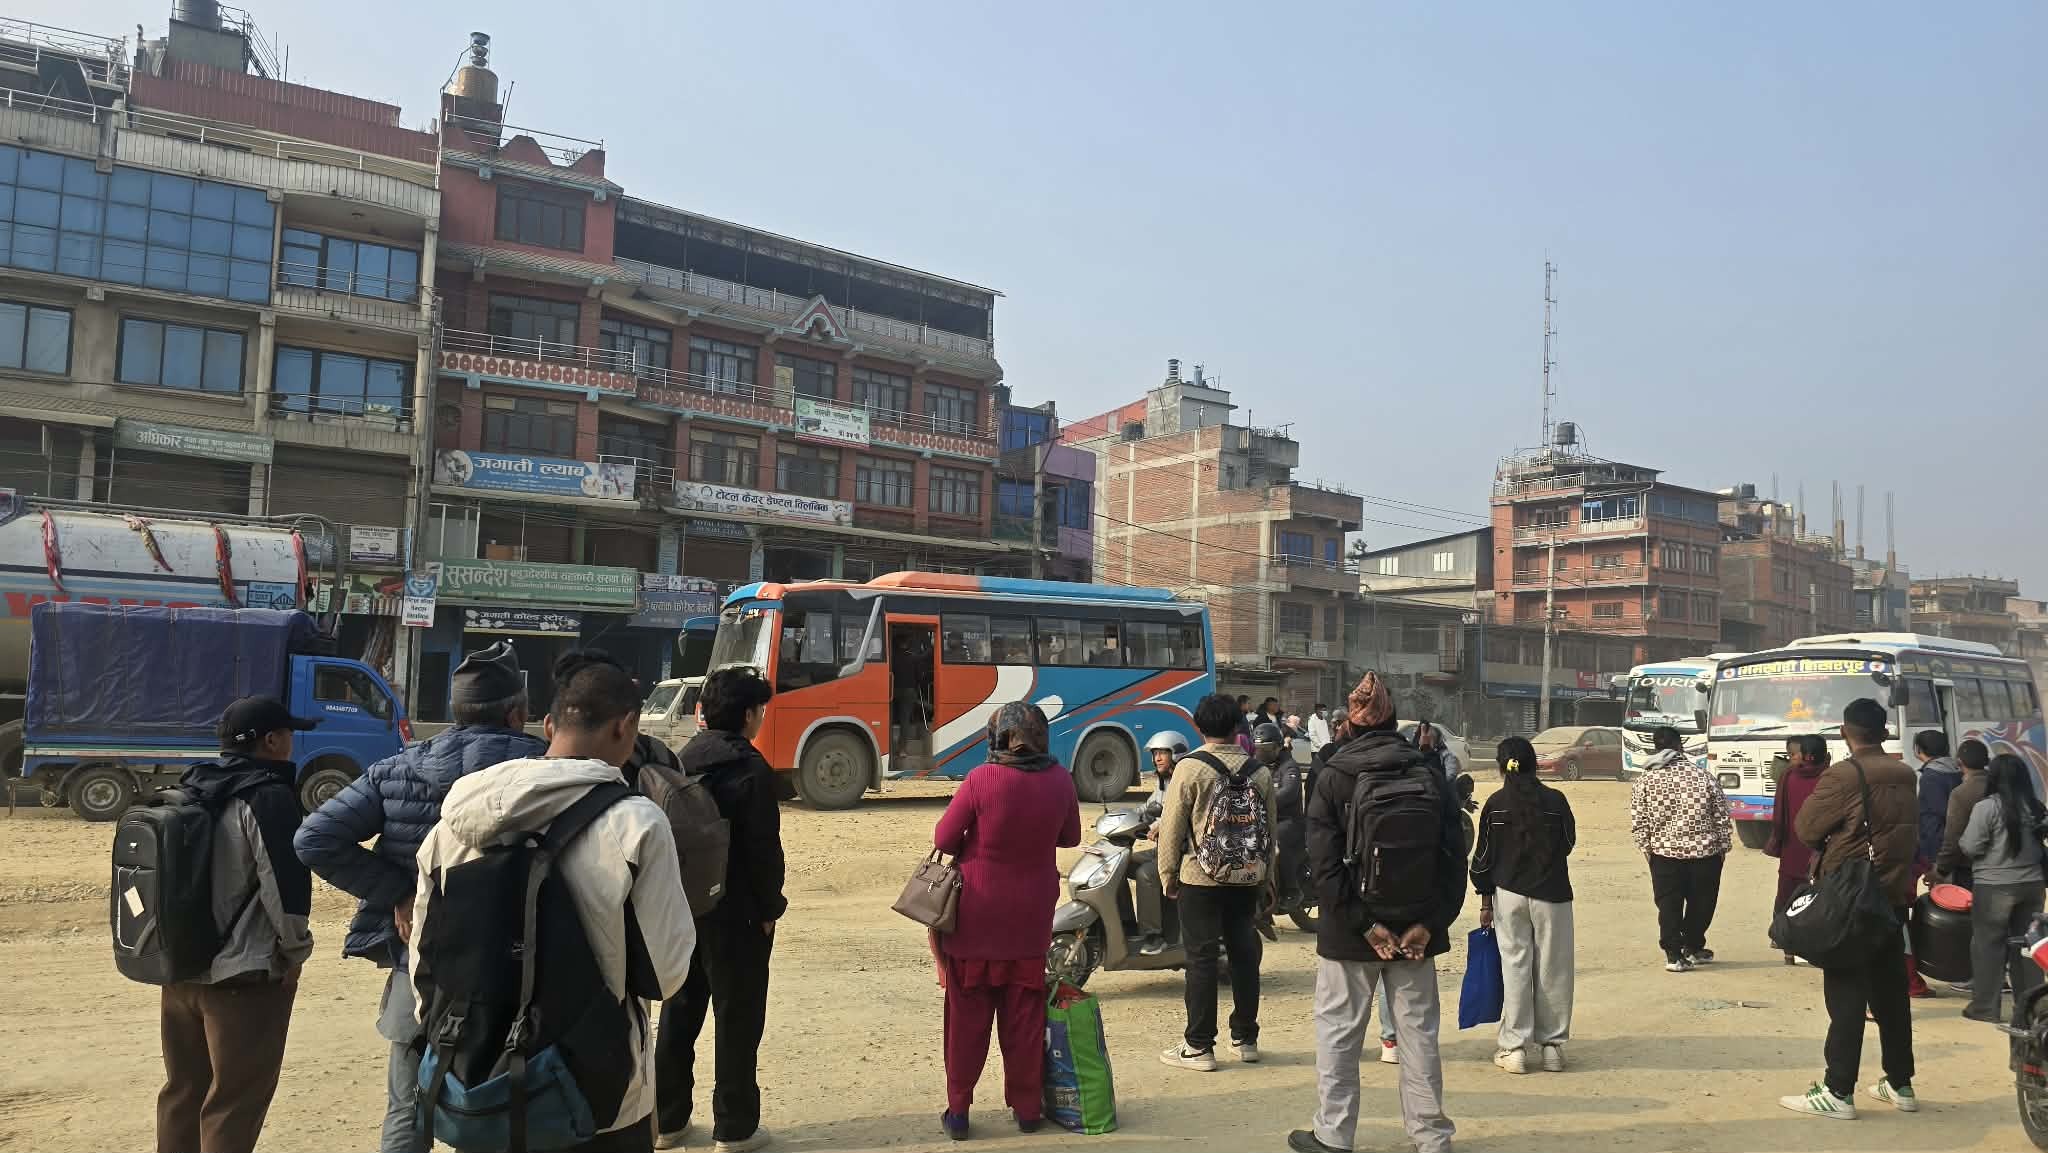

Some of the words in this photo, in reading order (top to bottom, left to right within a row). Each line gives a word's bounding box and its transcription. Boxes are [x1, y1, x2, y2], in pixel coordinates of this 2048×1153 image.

[136, 429, 182, 448] अधिकार
[473, 457, 534, 473] जगाती
[540, 463, 584, 477] ल्याब
[715, 489, 739, 501] टोटल
[742, 491, 764, 504] केयर
[446, 563, 508, 588] सुसन्देश
[1792, 894, 1812, 910] NIKE
